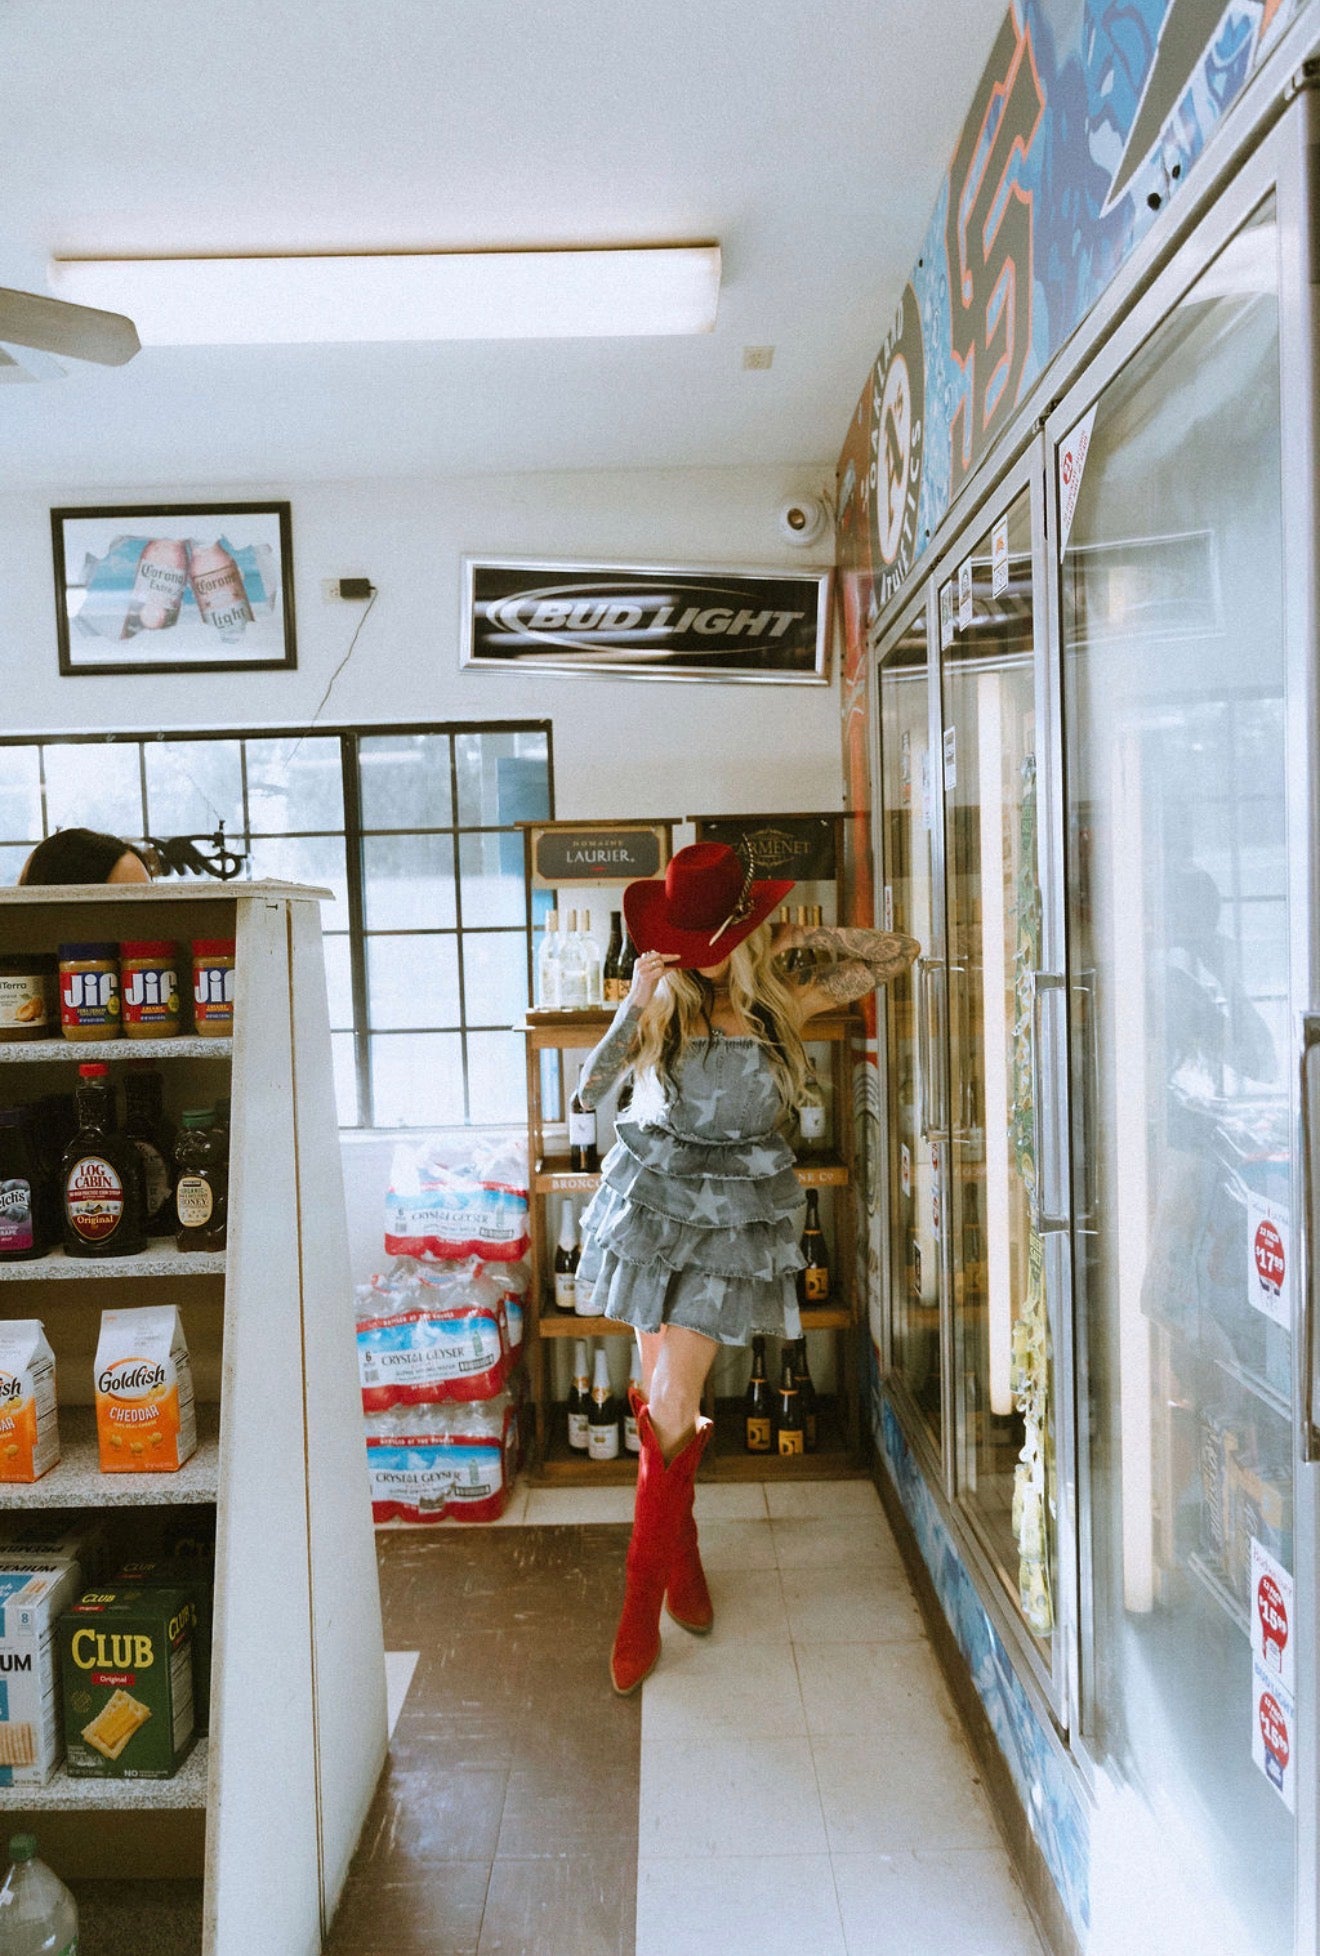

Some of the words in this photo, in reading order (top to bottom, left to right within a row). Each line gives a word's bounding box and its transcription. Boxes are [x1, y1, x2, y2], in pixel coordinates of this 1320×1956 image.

[141, 563, 184, 584] Corona
[211, 607, 247, 629] Light
[528, 601, 643, 631] BUD
[647, 606, 805, 637] LIGHT
[731, 840, 812, 855] ARMENET
[64, 973, 118, 1007] Jif
[125, 971, 177, 1005] Jif
[80, 1165, 105, 1176] LOG
[75, 1177, 112, 1188] CABIN
[77, 1215, 113, 1225] Original
[381, 1353, 423, 1366] CRYSTAL
[99, 1364, 165, 1393] Goldfish
[110, 1404, 160, 1422] CHEDDAR
[375, 1471, 418, 1482] CRYSTAL
[72, 1629, 154, 1669] CLUB
